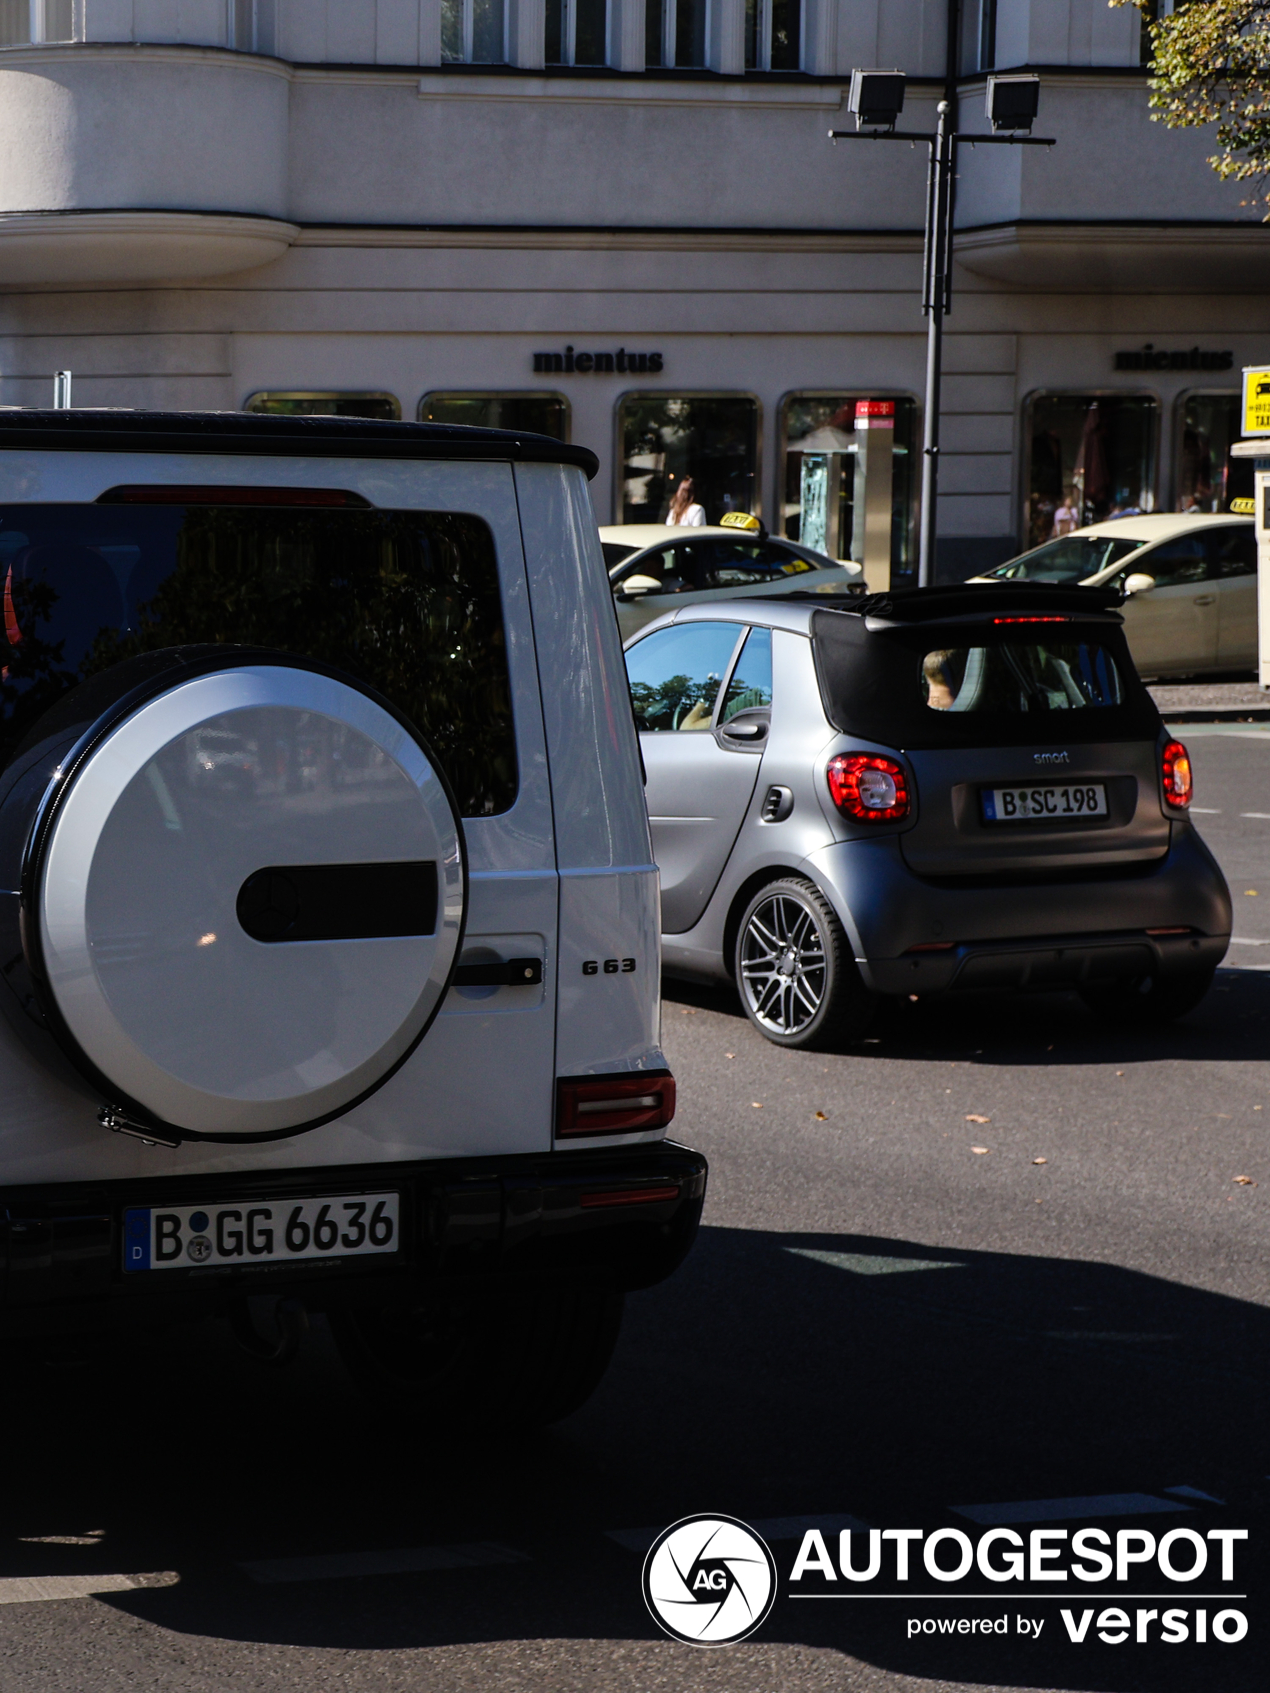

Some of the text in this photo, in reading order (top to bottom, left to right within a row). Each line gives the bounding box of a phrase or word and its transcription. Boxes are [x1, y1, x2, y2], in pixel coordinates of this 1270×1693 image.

[533, 345, 664, 373] mientus
[1115, 343, 1234, 371] mientus
[1033, 751, 1070, 764] smart
[1002, 787, 1098, 816] B SC 198
[582, 957, 636, 975] G 63
[132, 1201, 394, 1262] D B GG 6636
